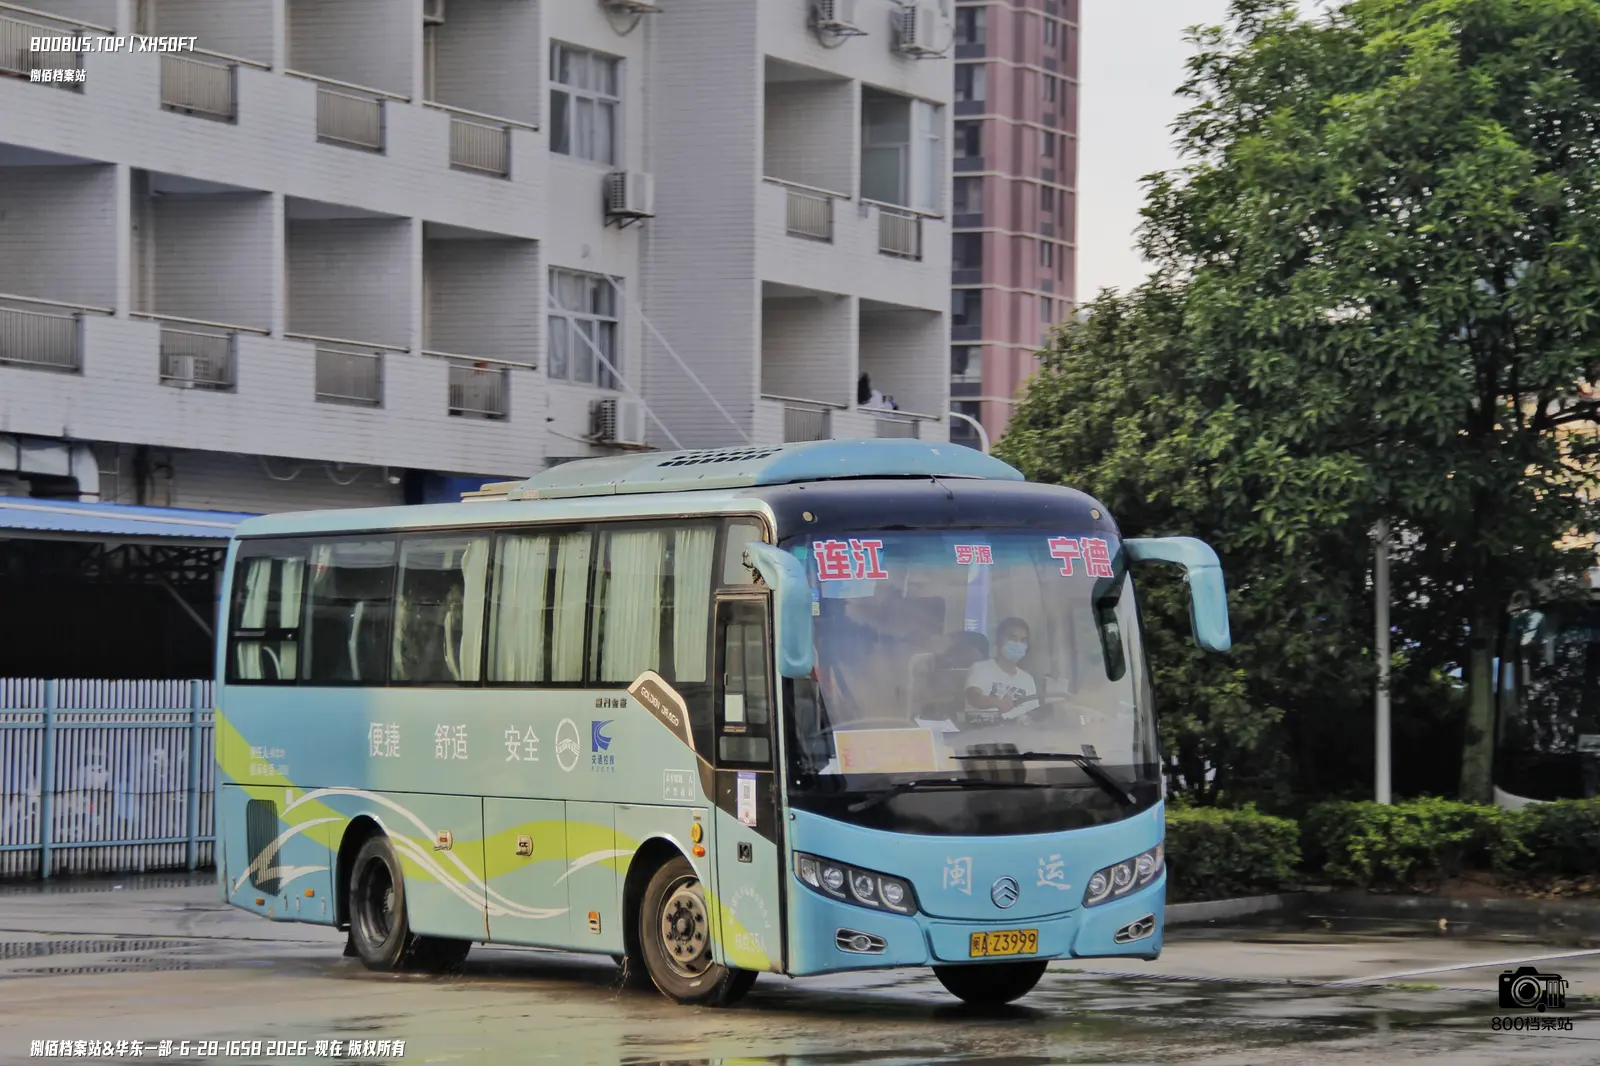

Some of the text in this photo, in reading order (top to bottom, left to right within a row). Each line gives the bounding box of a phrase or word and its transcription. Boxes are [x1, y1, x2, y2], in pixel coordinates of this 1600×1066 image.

[812, 539, 888, 581] 连江
[954, 544, 994, 565] 罗源
[1047, 536, 1115, 578] 宁德
[368, 722, 400, 757] 便捷
[434, 723, 468, 760] 舒适
[504, 725, 540, 762] 安全
